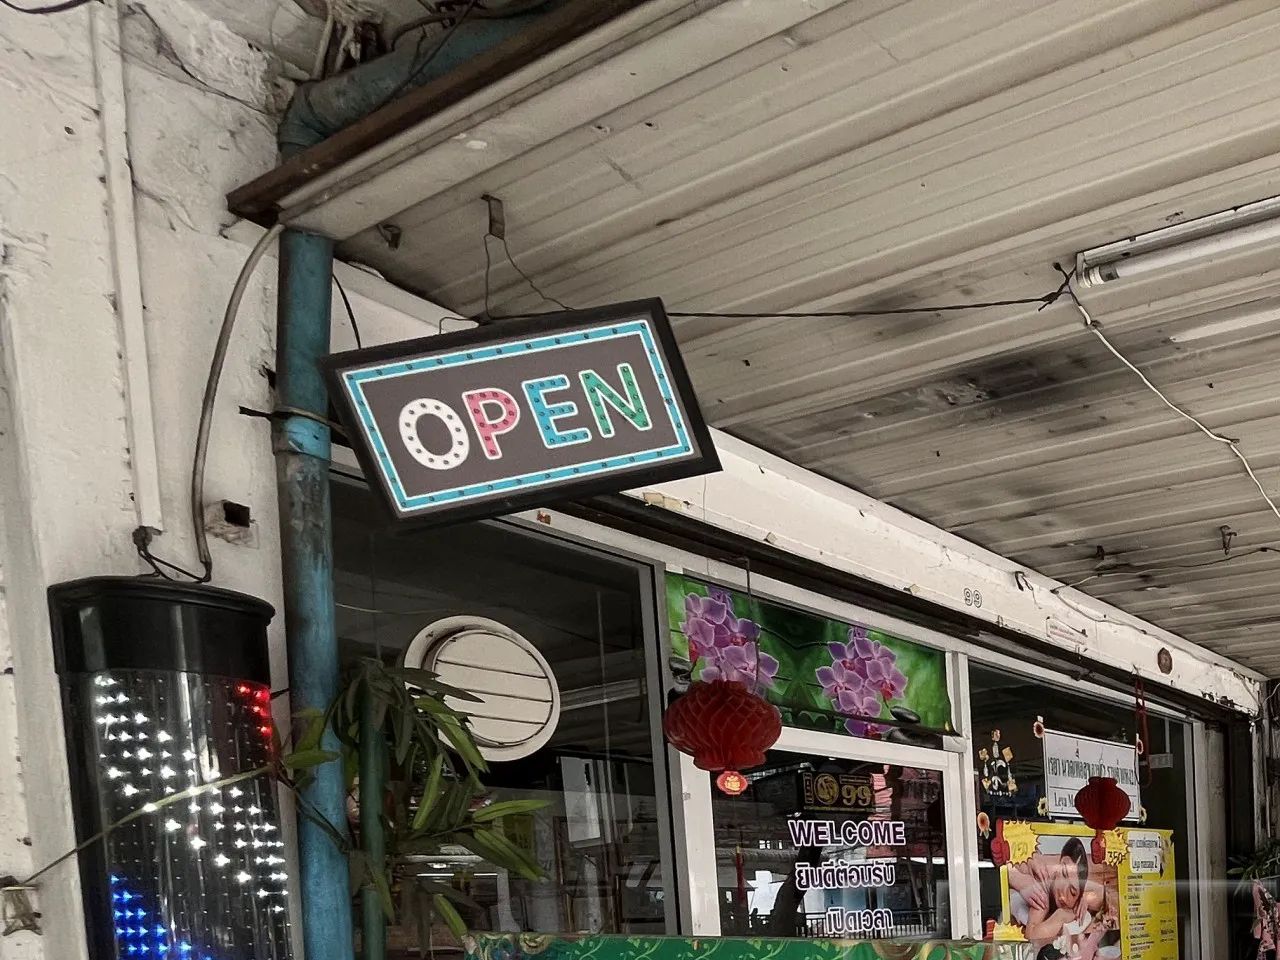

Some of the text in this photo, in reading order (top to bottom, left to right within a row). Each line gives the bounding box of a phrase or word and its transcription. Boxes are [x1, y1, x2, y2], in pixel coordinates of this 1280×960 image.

[398, 362, 654, 471] OPEN
[963, 587, 983, 609] 99
[788, 819, 907, 847] WELCOME
[795, 858, 896, 890] ยินดีต้อนรับ
[826, 906, 894, 935] เปิดเวลา
